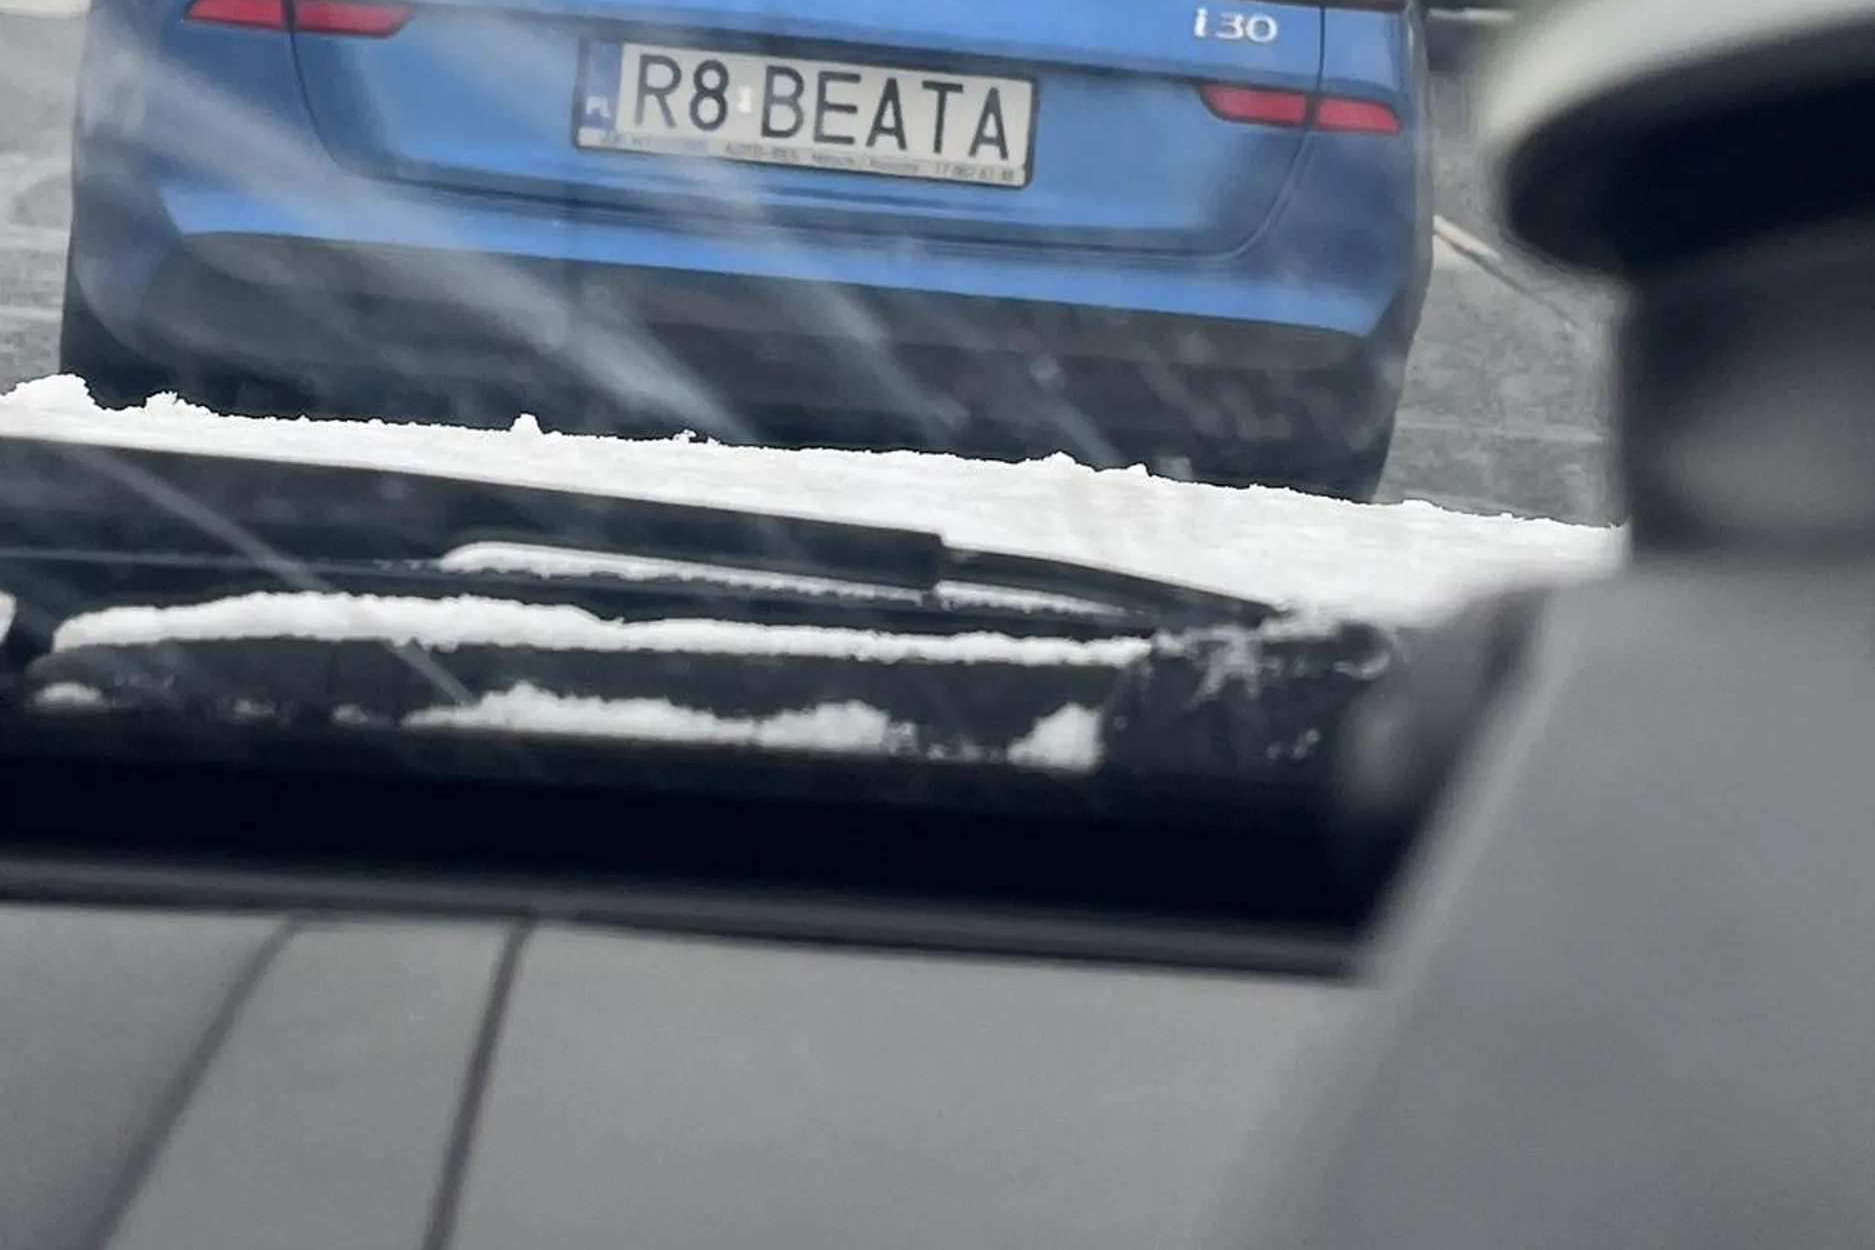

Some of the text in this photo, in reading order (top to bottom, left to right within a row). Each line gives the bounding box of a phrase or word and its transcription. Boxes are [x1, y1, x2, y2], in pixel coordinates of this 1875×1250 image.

[1194, 7, 1278, 43] i30
[633, 53, 1009, 160] R8 BEATA
